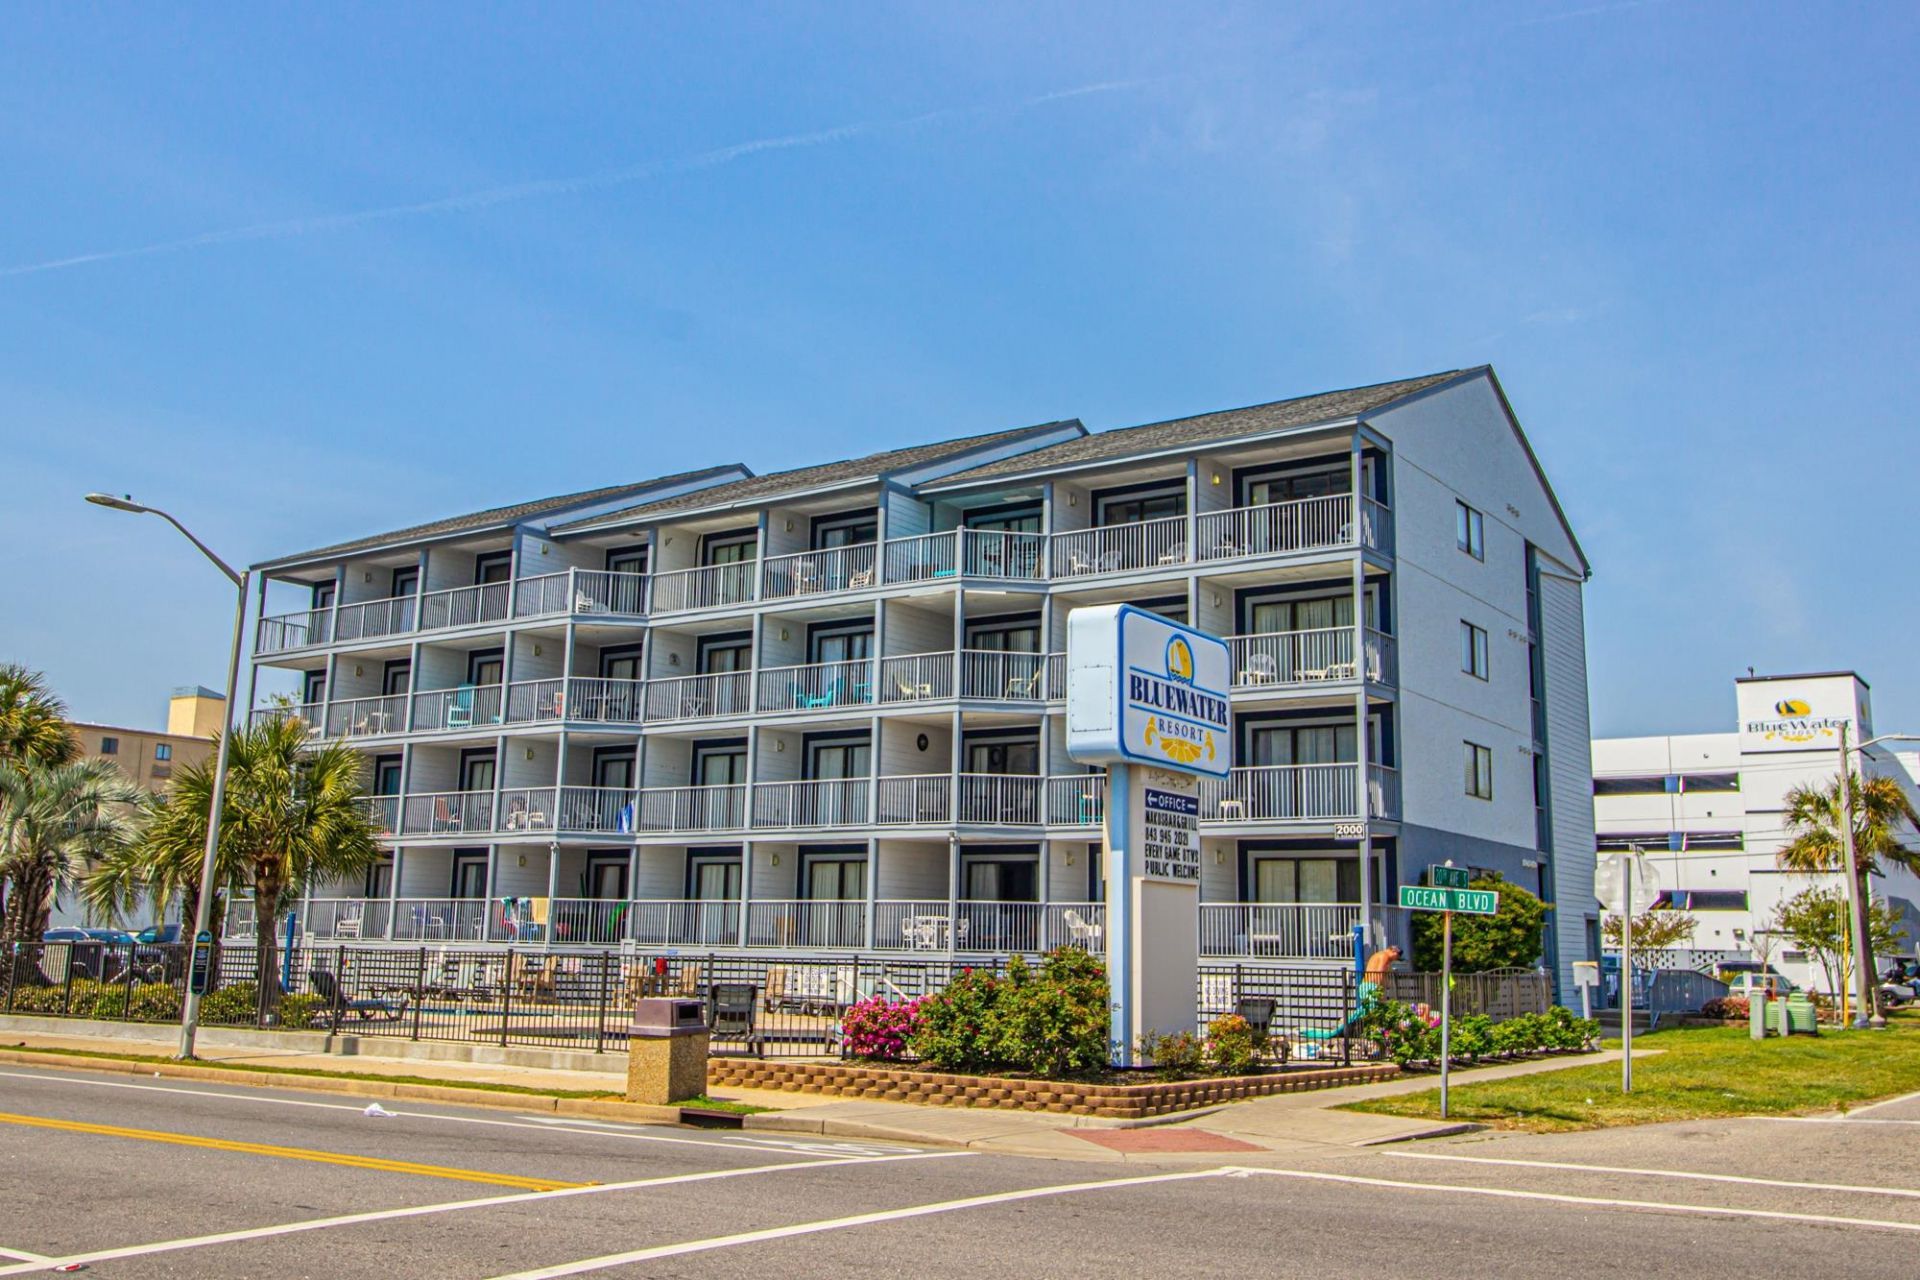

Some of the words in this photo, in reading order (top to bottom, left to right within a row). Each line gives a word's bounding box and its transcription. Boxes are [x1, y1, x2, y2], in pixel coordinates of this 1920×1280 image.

[1130, 674, 1227, 726] BLUEWATER
[1159, 718, 1203, 741] RESORT
[1158, 795, 1186, 810] OFFICE
[1336, 825, 1363, 835] 2000
[1145, 843, 1163, 859] EVERY
[1164, 846, 1181, 861] GAME
[1145, 860, 1169, 876] PUBLIC
[1172, 863, 1199, 880] WELCOME
[1407, 890, 1446, 907] OCEAN
[1458, 893, 1489, 910] BLVD
